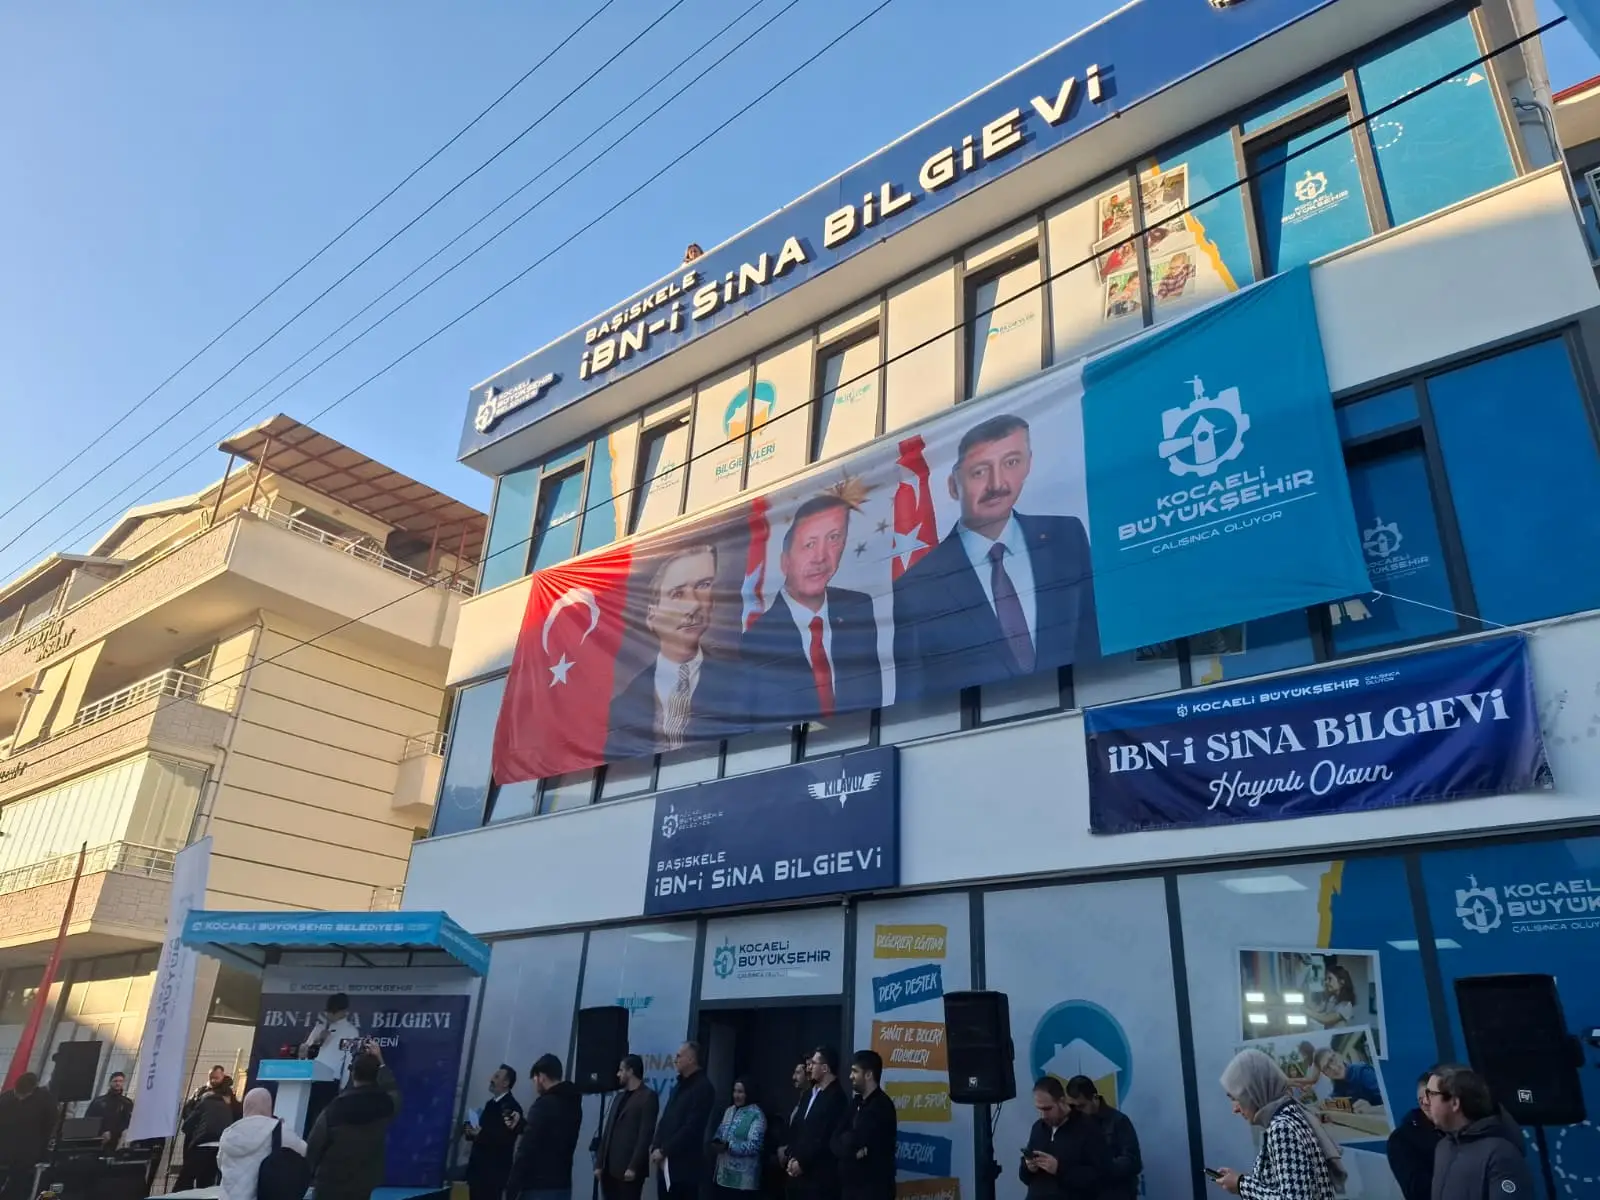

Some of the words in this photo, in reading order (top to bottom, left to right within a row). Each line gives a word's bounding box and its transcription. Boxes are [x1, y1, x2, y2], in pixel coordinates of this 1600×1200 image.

[1225, 511, 1283, 533] OLUYOR
[824, 776, 865, 796] KILAVUZ
[1207, 770, 1305, 810] Hayırlı
[1309, 759, 1394, 795] Olsun
[879, 981, 903, 1003] DERS
[905, 972, 938, 996] DESTEK
